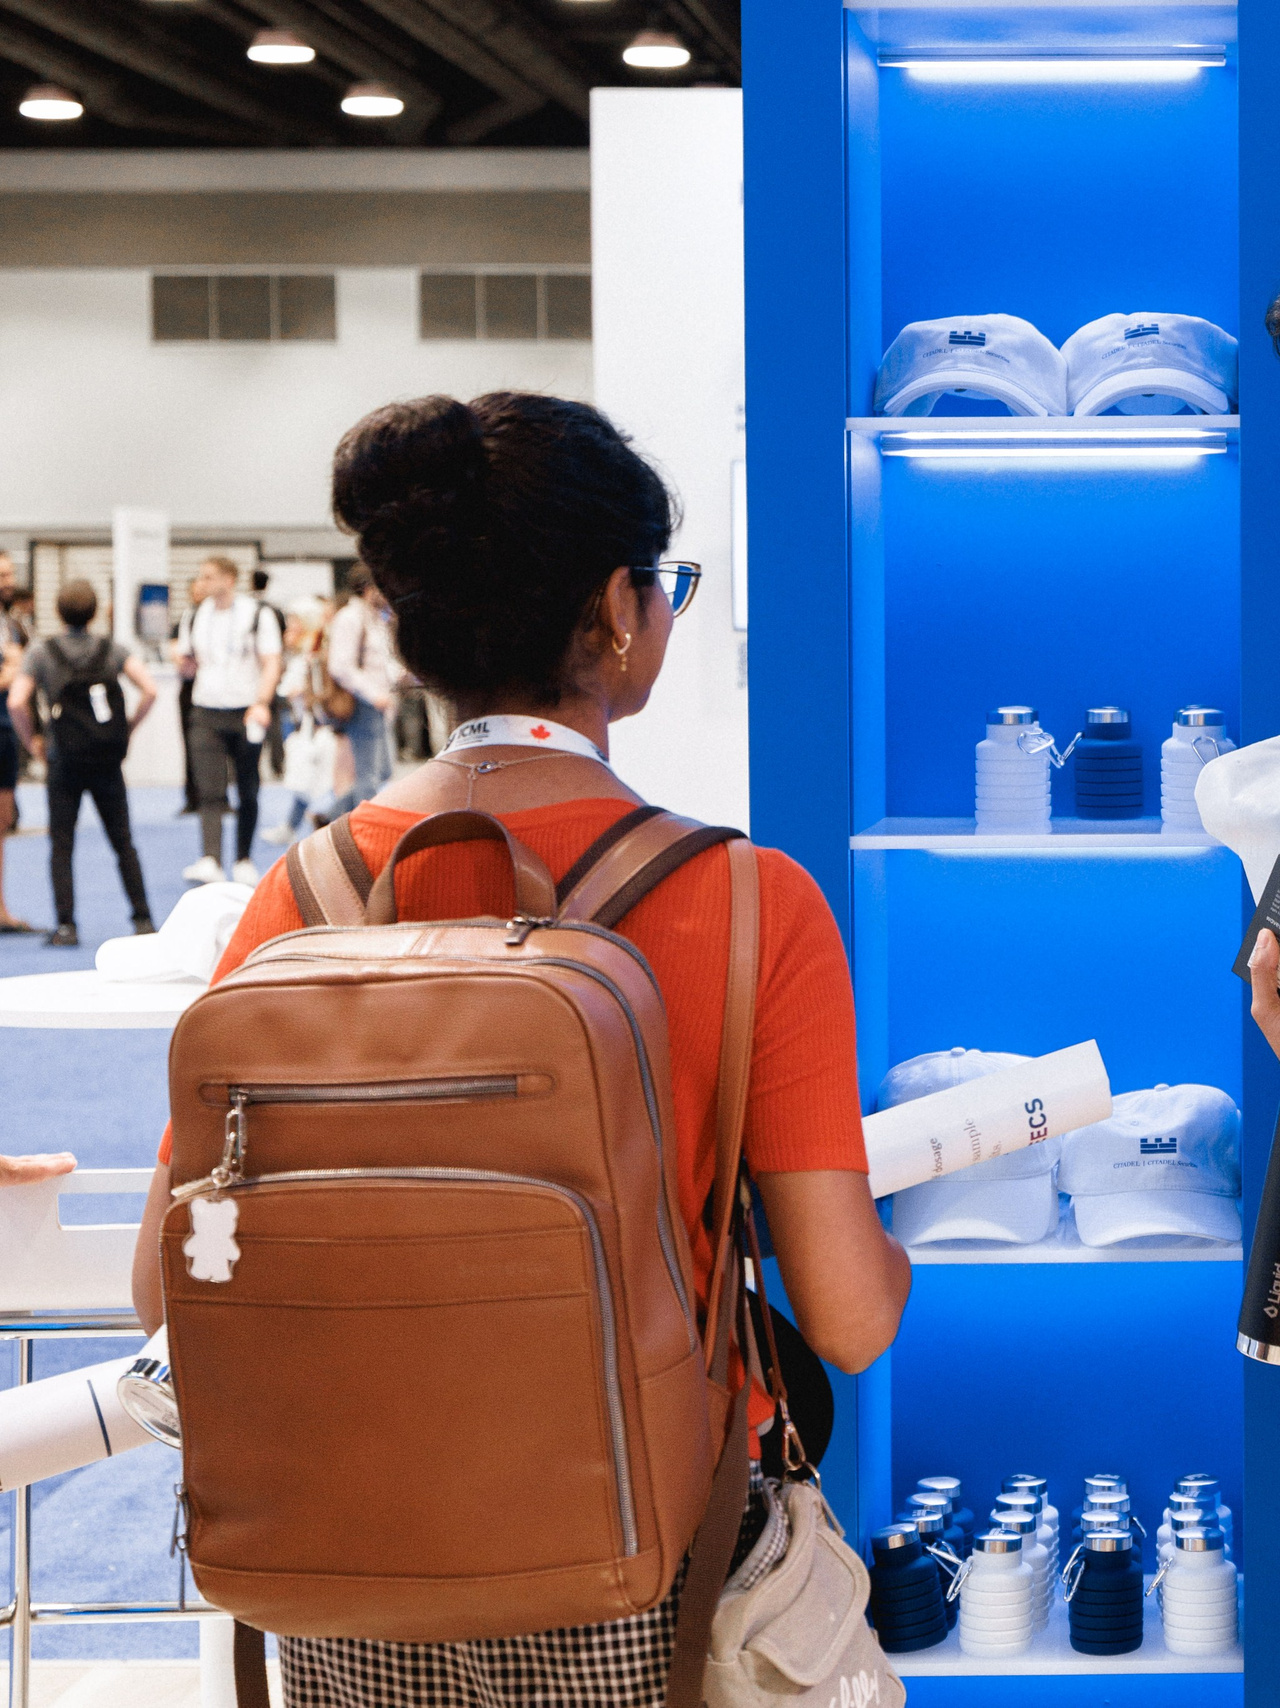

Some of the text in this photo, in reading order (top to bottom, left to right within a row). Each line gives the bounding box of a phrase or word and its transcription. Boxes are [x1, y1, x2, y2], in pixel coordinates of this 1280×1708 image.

[922, 348, 948, 359] CITADEL
[1101, 345, 1126, 360] CITADEL
[1025, 1098, 1048, 1146] ECS
[963, 1118, 981, 1162] sample
[930, 1138, 943, 1173] dosage
[1113, 1160, 1141, 1169] CITADEL
[1147, 1159, 1176, 1167] CITADEL
